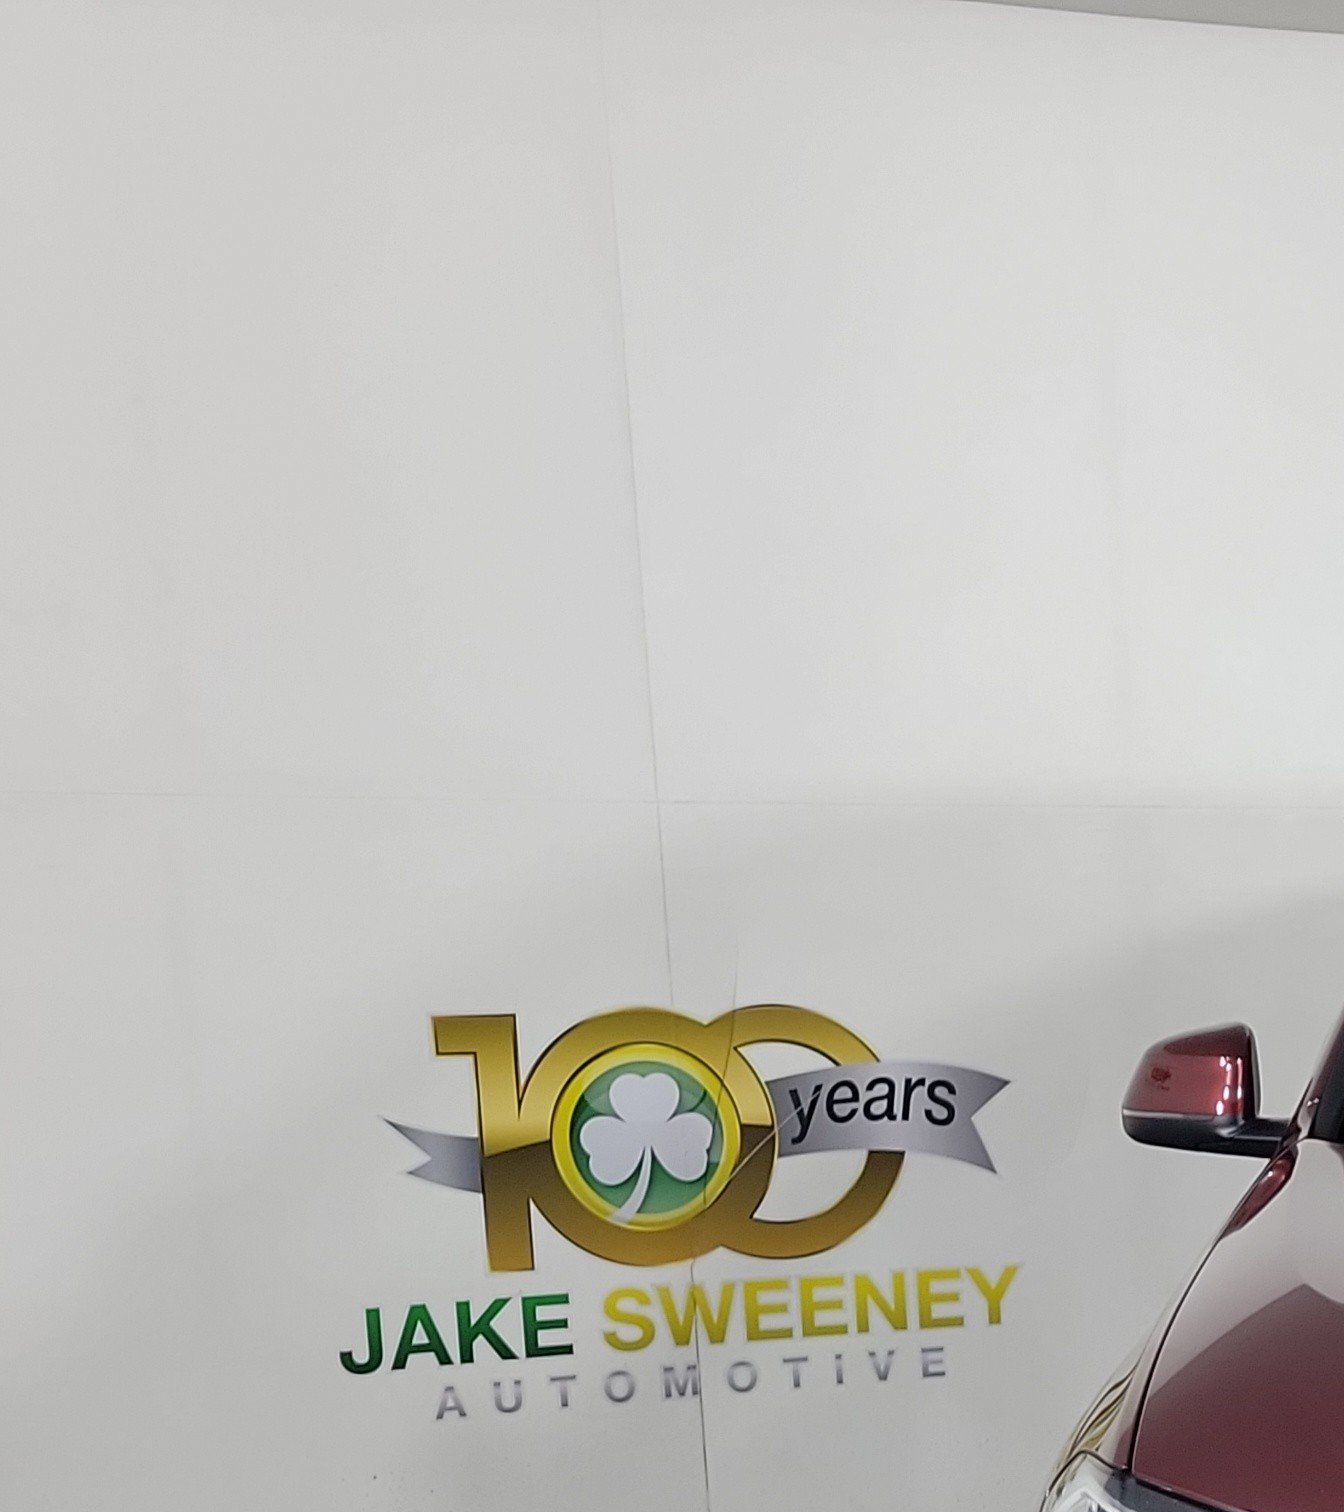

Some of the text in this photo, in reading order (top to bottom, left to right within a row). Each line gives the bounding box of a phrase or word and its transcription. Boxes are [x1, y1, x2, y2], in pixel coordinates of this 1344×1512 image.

[431, 1003, 905, 1273] 100
[788, 1075, 958, 1145] years
[338, 1264, 1021, 1376] JAKE SWEENEY
[435, 1346, 947, 1421] AUTOMOTIVE
